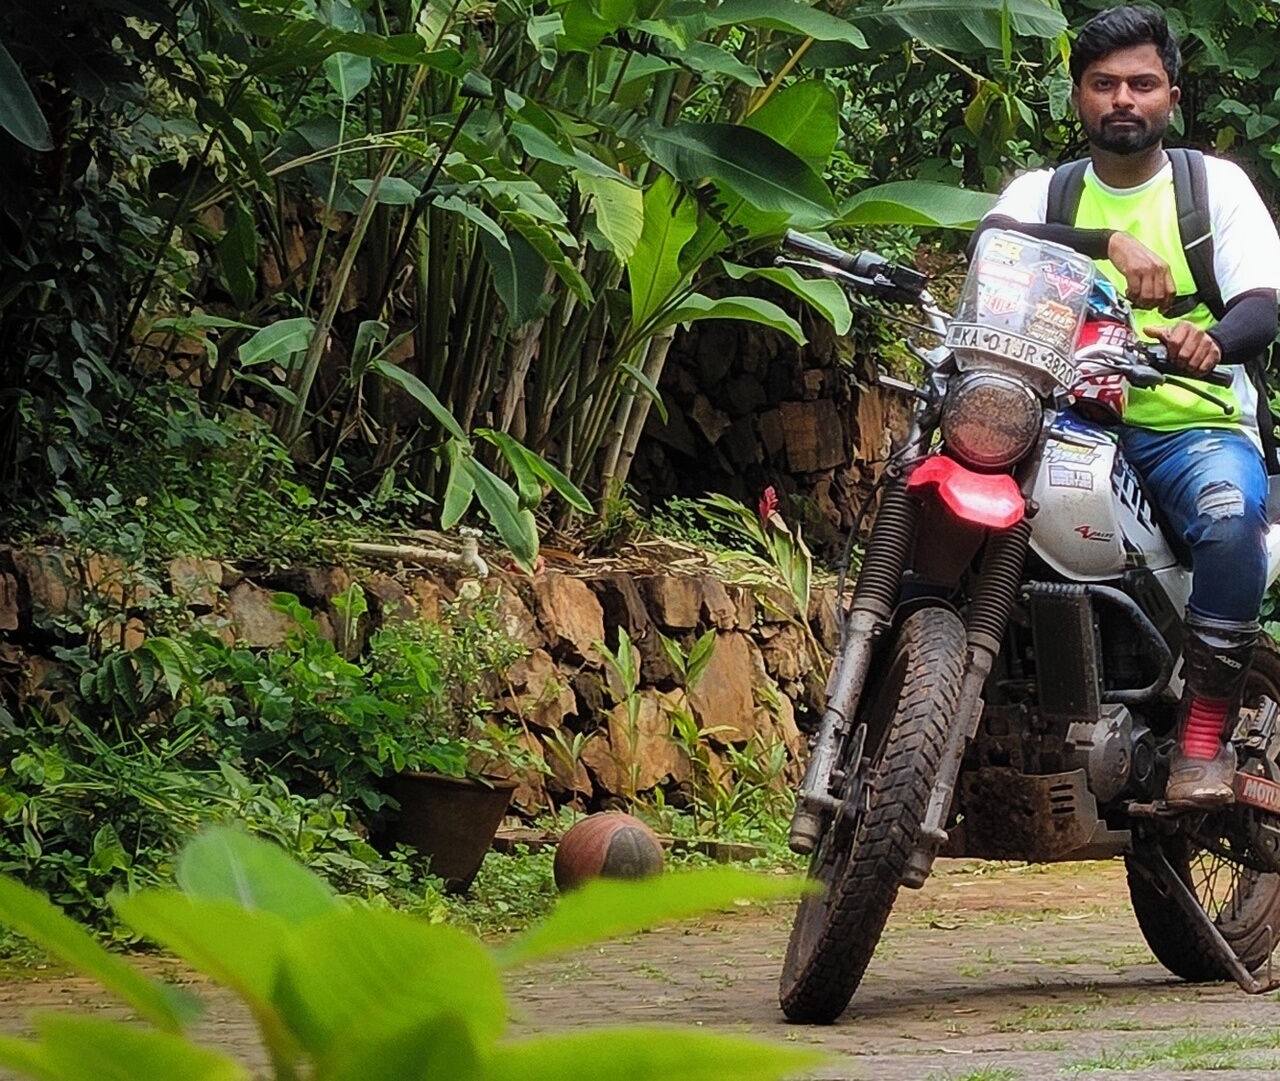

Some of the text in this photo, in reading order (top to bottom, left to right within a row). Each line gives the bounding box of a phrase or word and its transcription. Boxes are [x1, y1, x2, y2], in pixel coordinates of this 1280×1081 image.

[960, 328, 978, 346] KA
[987, 333, 1037, 364] 01JR
[1045, 353, 1074, 389] 3820
